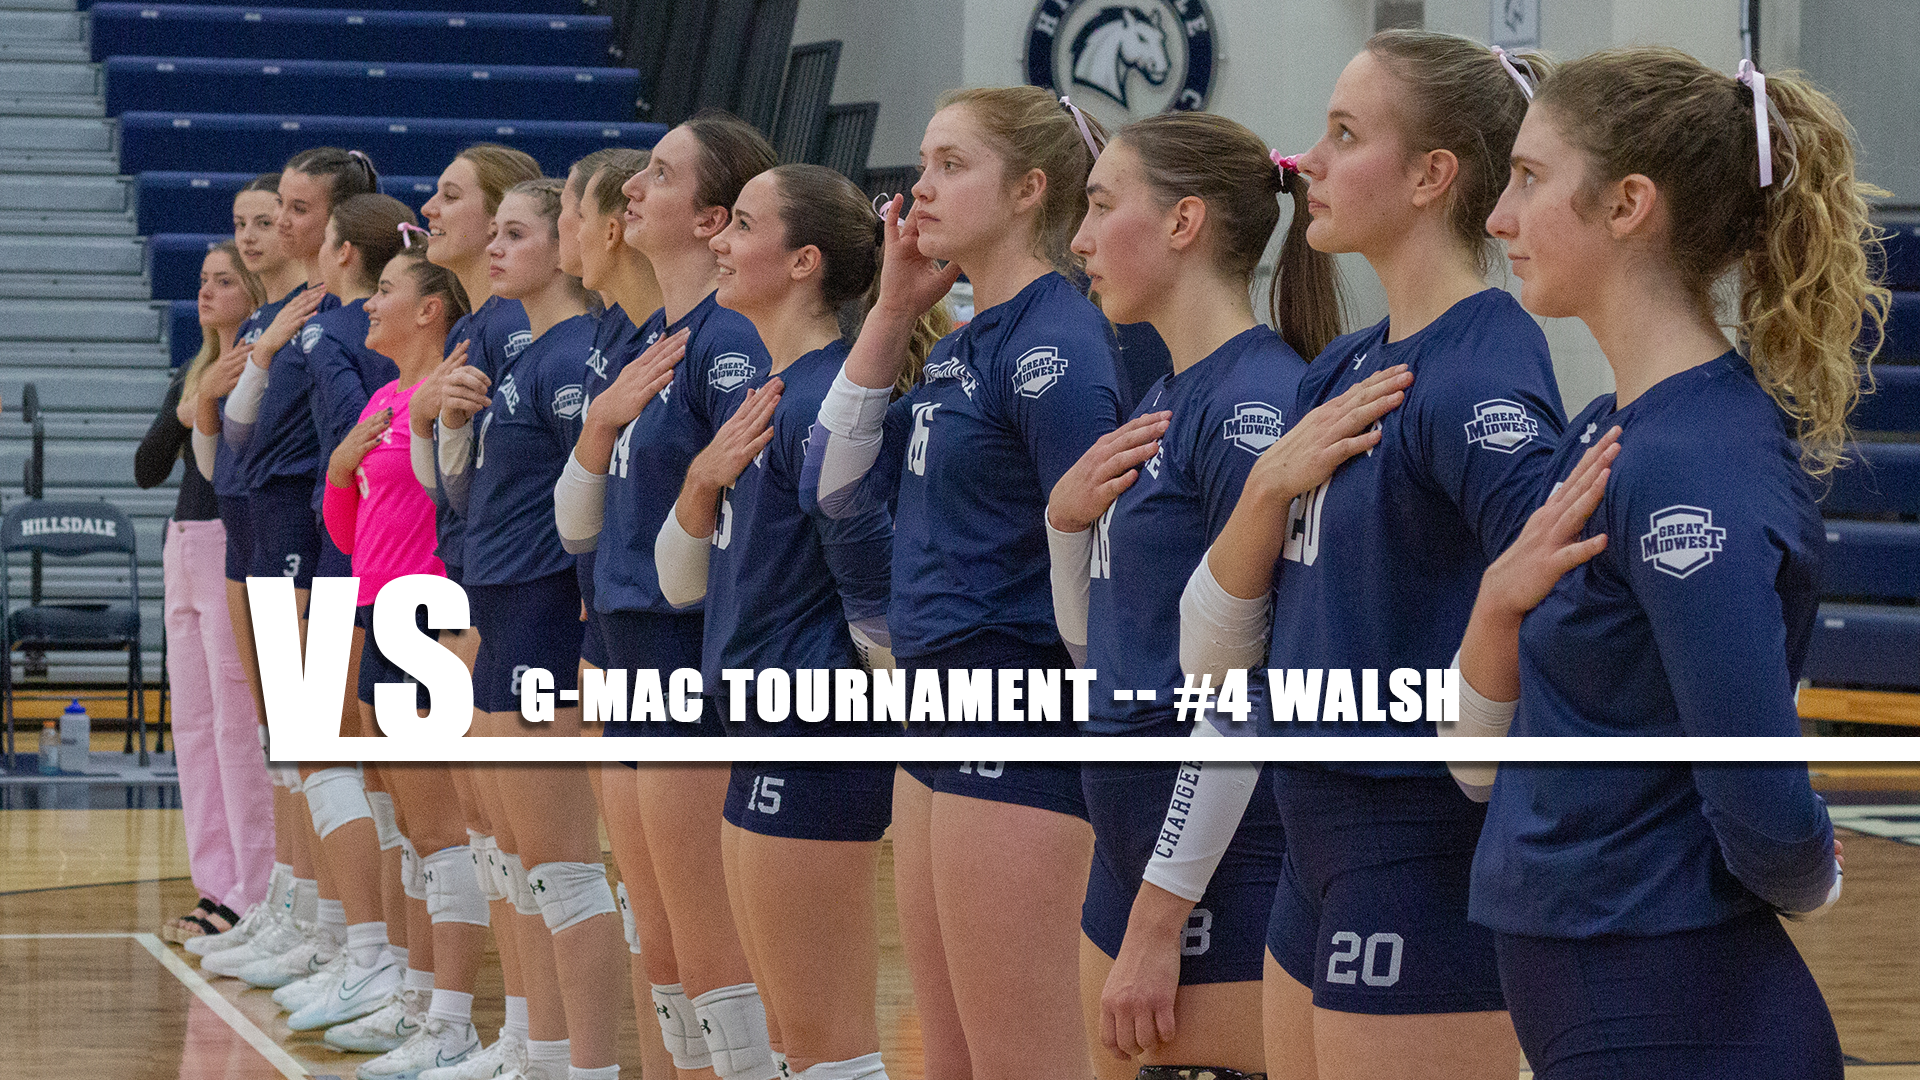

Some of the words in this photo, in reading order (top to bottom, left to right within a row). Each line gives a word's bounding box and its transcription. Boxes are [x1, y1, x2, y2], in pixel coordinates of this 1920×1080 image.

[718, 362, 745, 370] GREAT
[1022, 357, 1052, 373] GREAT
[709, 367, 754, 383] MIDWEST
[1013, 360, 1067, 391] MIDWEST
[554, 398, 583, 413] MIDWE
[1241, 414, 1276, 426] GREAT
[1483, 412, 1522, 424] GREAT
[1466, 418, 1536, 442] MIDWEST
[21, 516, 117, 538] HILLSDALE
[1658, 523, 1703, 538] GREAT
[1642, 529, 1724, 559] MIDWEST
[283, 553, 301, 577] 3
[747, 775, 785, 815] 15
[1326, 931, 1404, 987] 20
